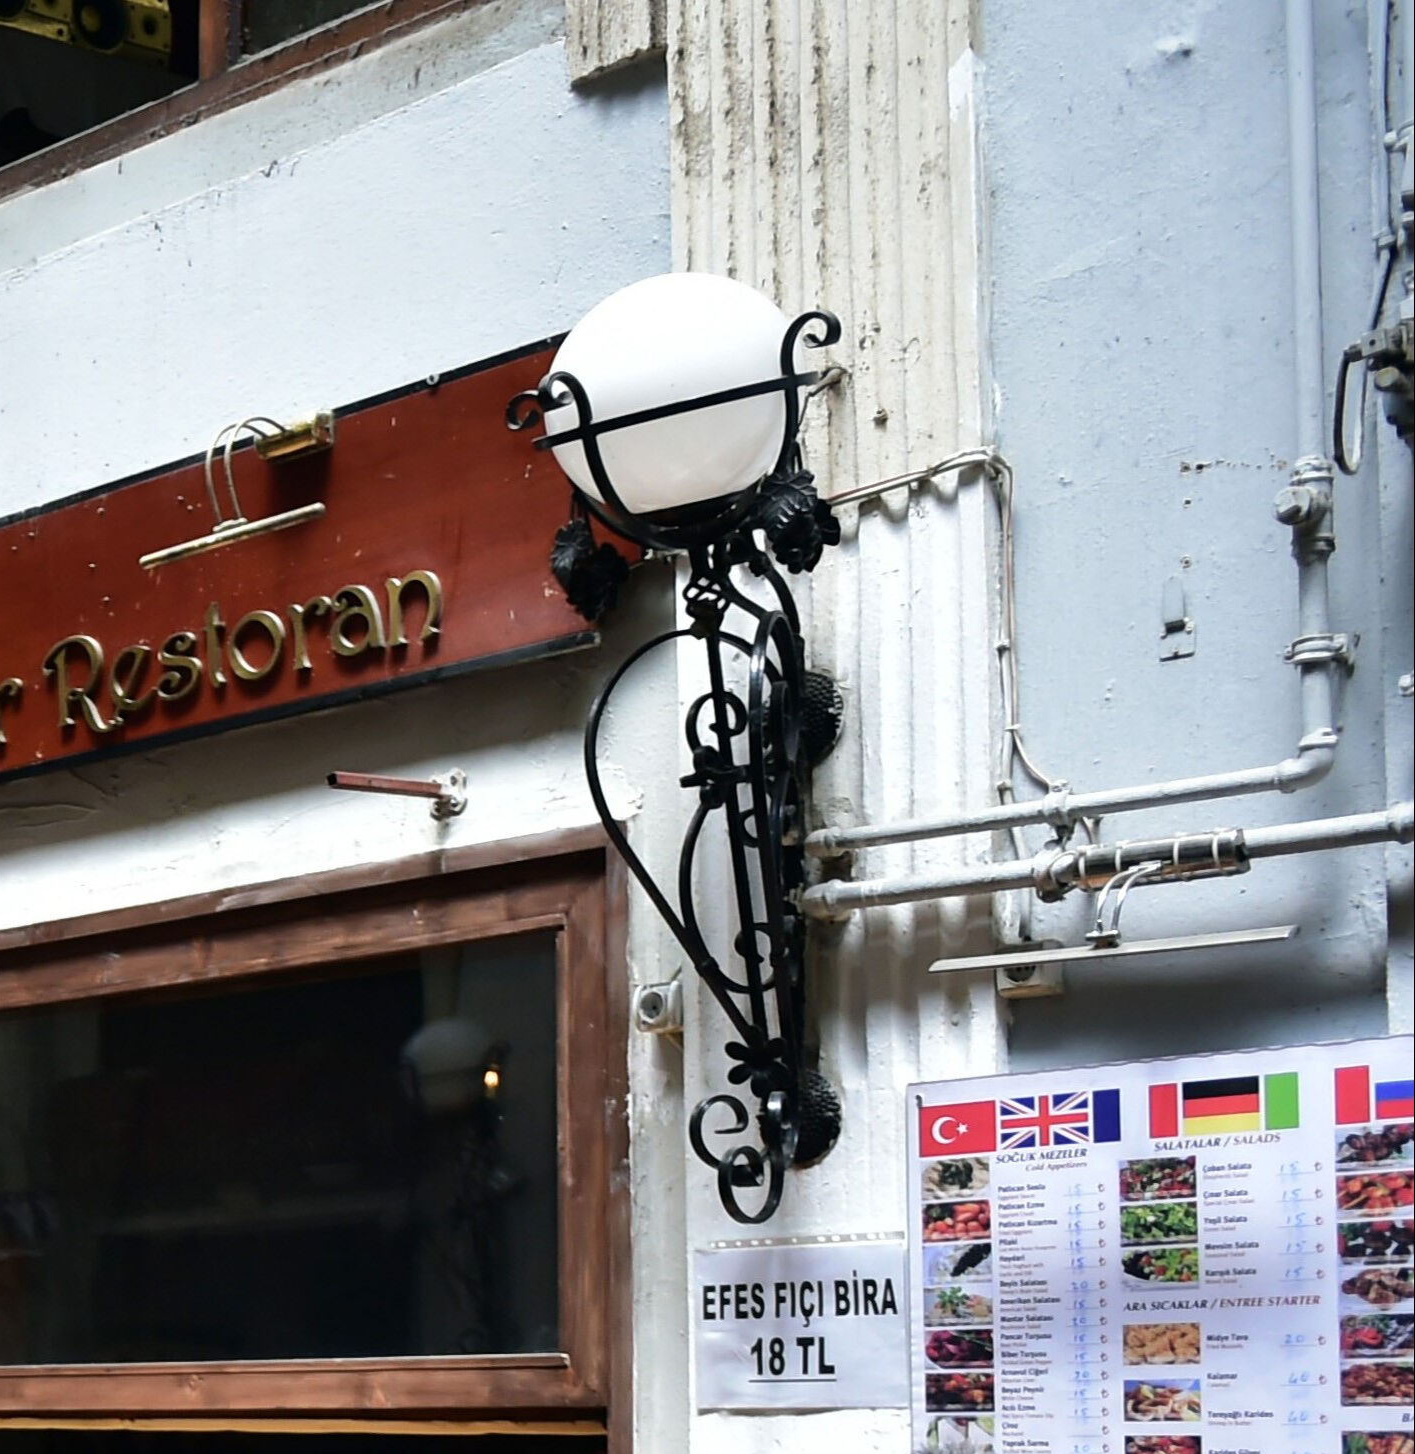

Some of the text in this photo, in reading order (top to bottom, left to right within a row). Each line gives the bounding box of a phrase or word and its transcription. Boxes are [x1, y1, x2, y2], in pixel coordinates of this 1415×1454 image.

[43, 570, 443, 733] Restoran
[996, 1149, 1087, 1164] SOĞUK MEZELER
[1154, 1137, 1221, 1151] SALATALAR
[1233, 1133, 1281, 1145] SALADS
[703, 1269, 898, 1327] EFES FIÇI BİRA
[1123, 1302, 1146, 1312] ARA
[1220, 1298, 1263, 1308] ENTREE
[1268, 1295, 1321, 1306] STARTER
[750, 1336, 835, 1376] 18 TL
